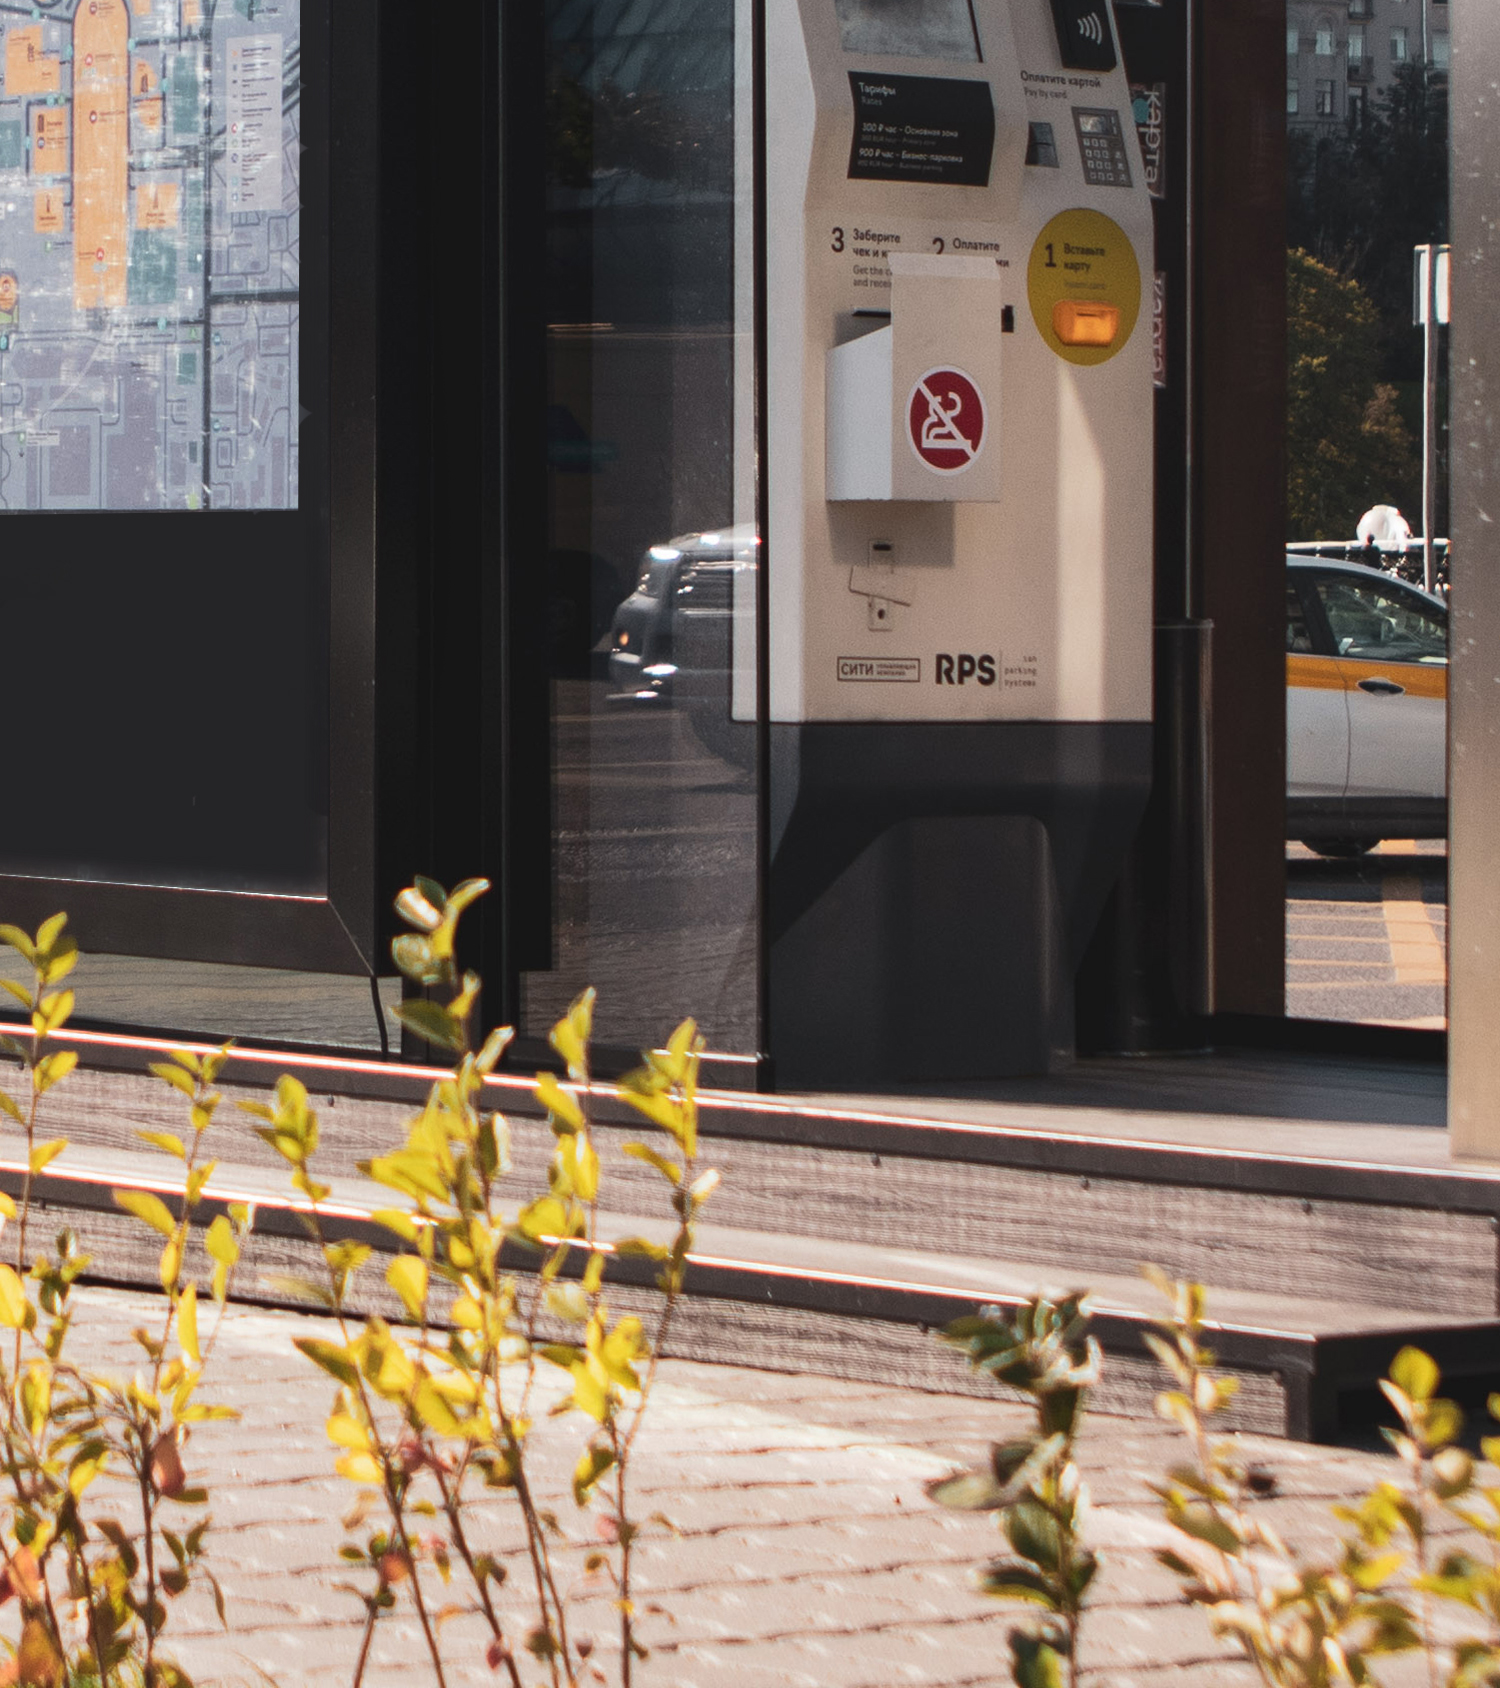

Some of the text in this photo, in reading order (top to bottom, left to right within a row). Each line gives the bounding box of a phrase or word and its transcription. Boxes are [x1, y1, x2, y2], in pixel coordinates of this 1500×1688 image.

[1020, 70, 1102, 90] Оплатите картой
[858, 81, 897, 98] Тарифы
[831, 226, 901, 253] 3 Заберите
[951, 238, 1001, 252] Оплатите
[852, 246, 871, 258] чек
[1044, 242, 1057, 268] 1
[1063, 262, 1092, 274] карту
[869, 279, 892, 289] recei
[840, 663, 873, 676] СИТИ
[935, 653, 996, 687] RPS
